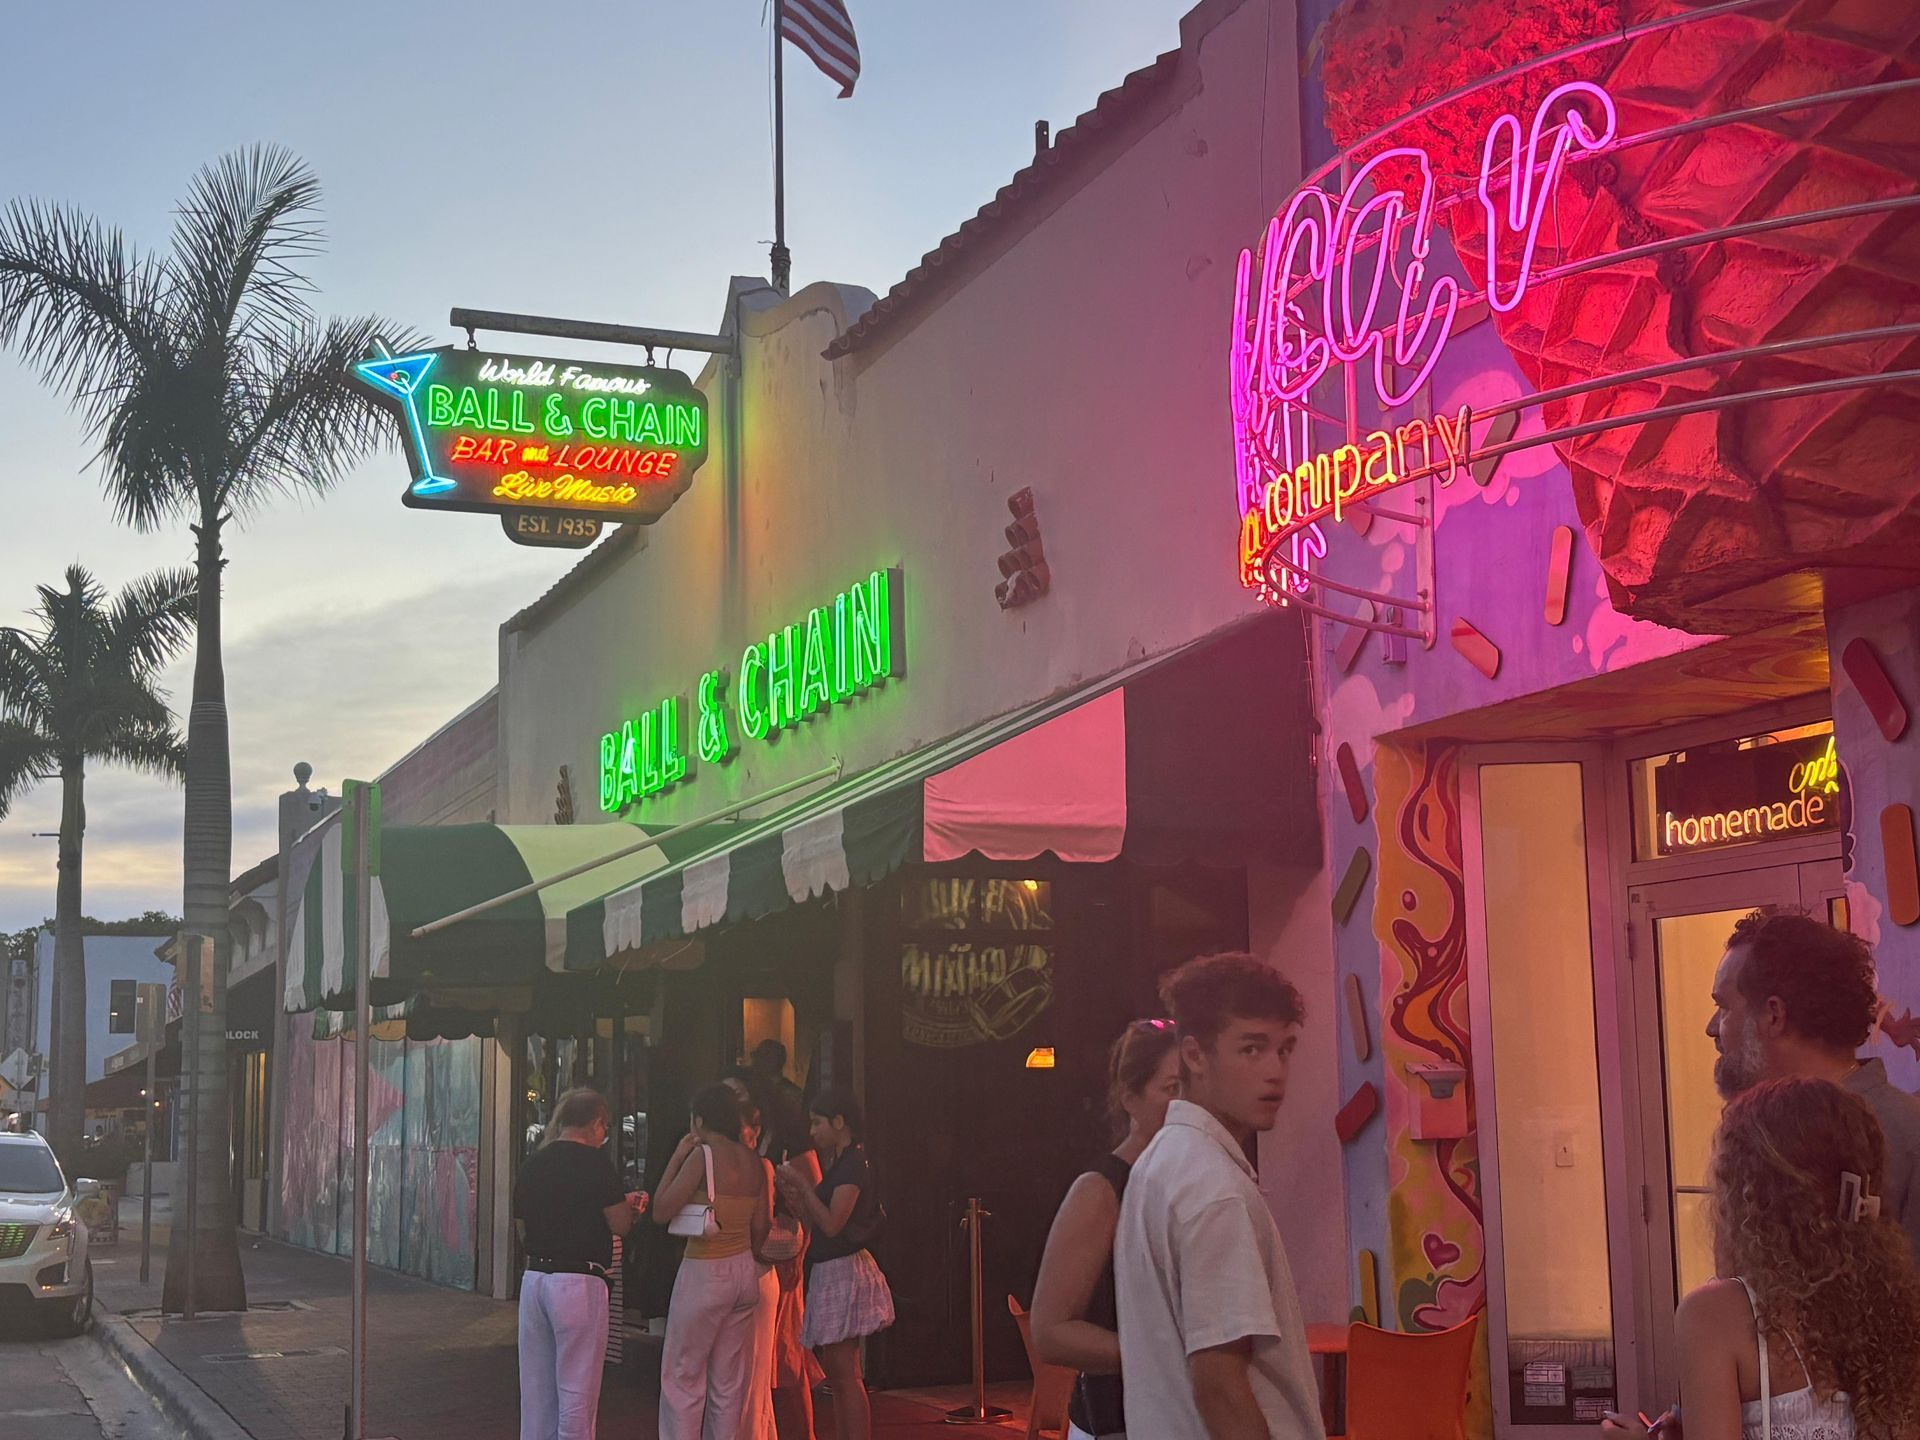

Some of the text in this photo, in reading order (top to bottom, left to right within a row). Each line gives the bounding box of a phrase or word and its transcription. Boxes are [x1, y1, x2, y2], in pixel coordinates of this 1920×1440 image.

[478, 358, 652, 395] World Famous
[427, 384, 701, 447] BALL & CHAIN
[451, 436, 677, 476] BAR and LOUNGE
[492, 470, 637, 505] Live Music
[517, 514, 597, 536] EST. 1935
[600, 570, 891, 812] BALL & CHAIN
[1665, 788, 1825, 847] homemade
